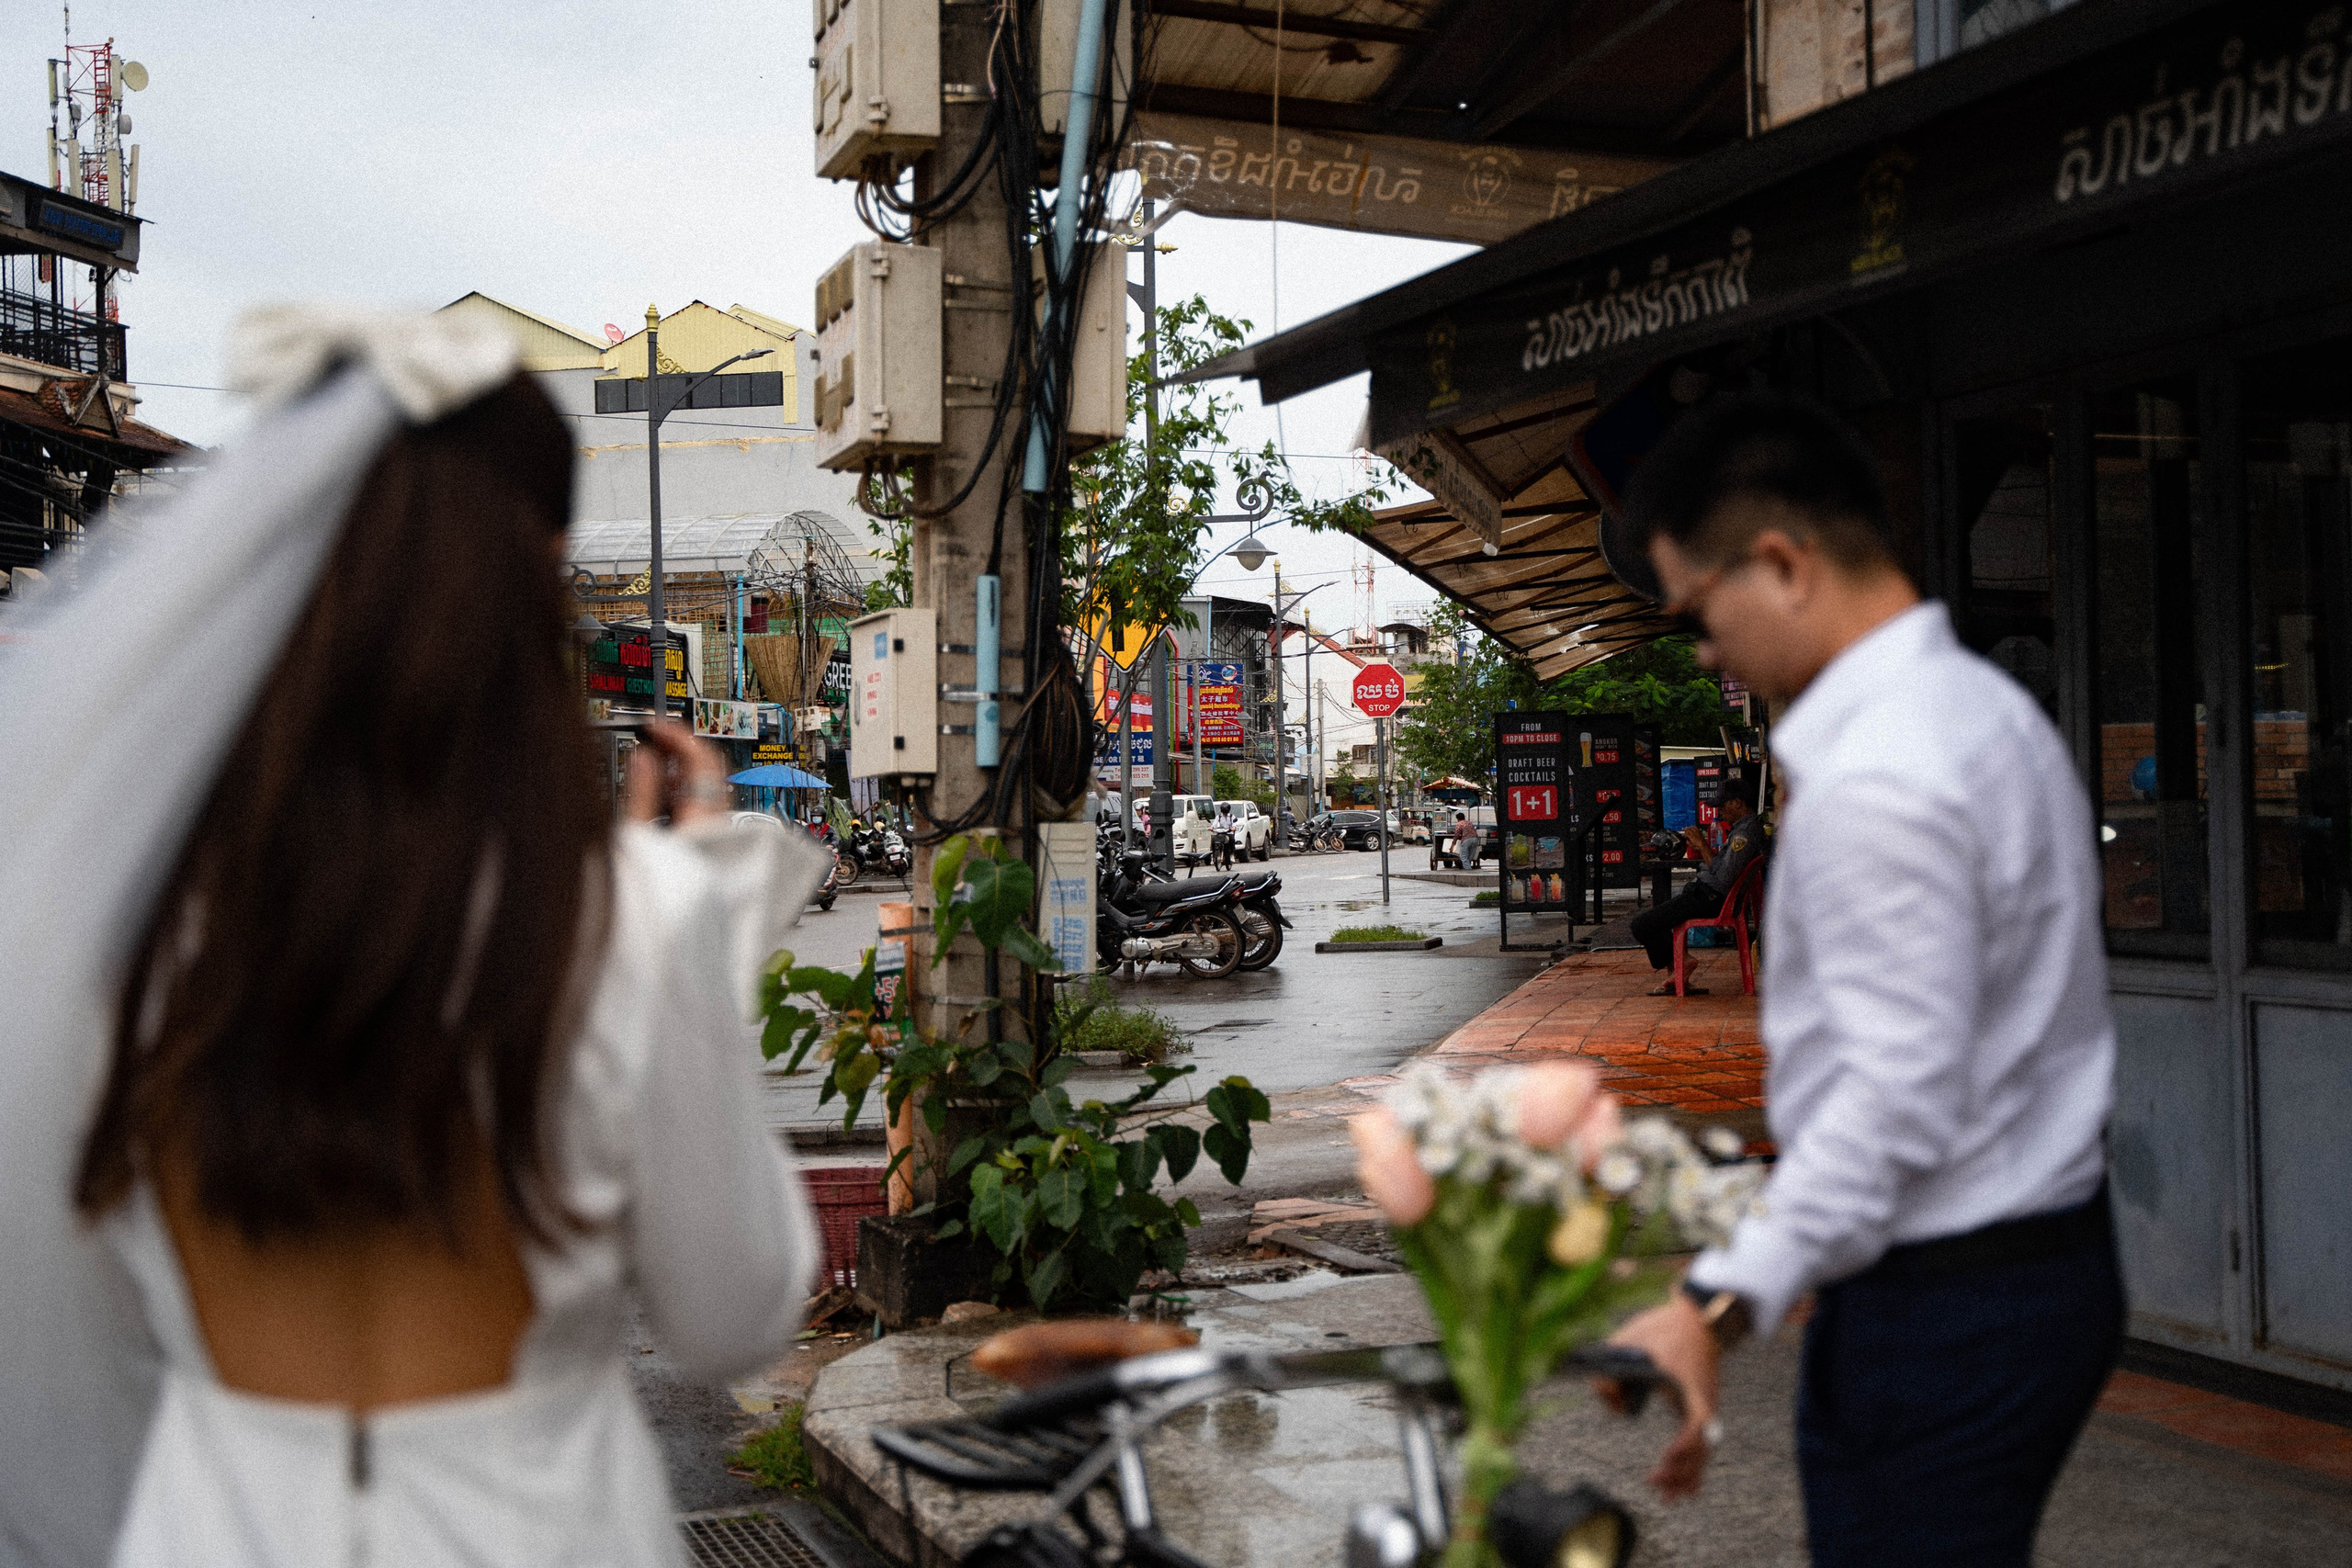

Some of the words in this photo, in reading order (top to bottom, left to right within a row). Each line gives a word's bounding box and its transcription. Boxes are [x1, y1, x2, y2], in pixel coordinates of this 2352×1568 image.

[665, 681, 687, 698] ASSAGE
[1356, 678, 1399, 700] ឈប់
[1368, 704, 1391, 712] STOP
[1521, 723, 1542, 731] FROM
[1506, 735, 1524, 743] 10PM
[759, 744, 786, 752] MONEY
[1508, 758, 1532, 768] DRAFT
[1536, 757, 1555, 767] BEER
[1508, 772, 1556, 783] COCKTAILS
[1512, 790, 1551, 816] 1+1
